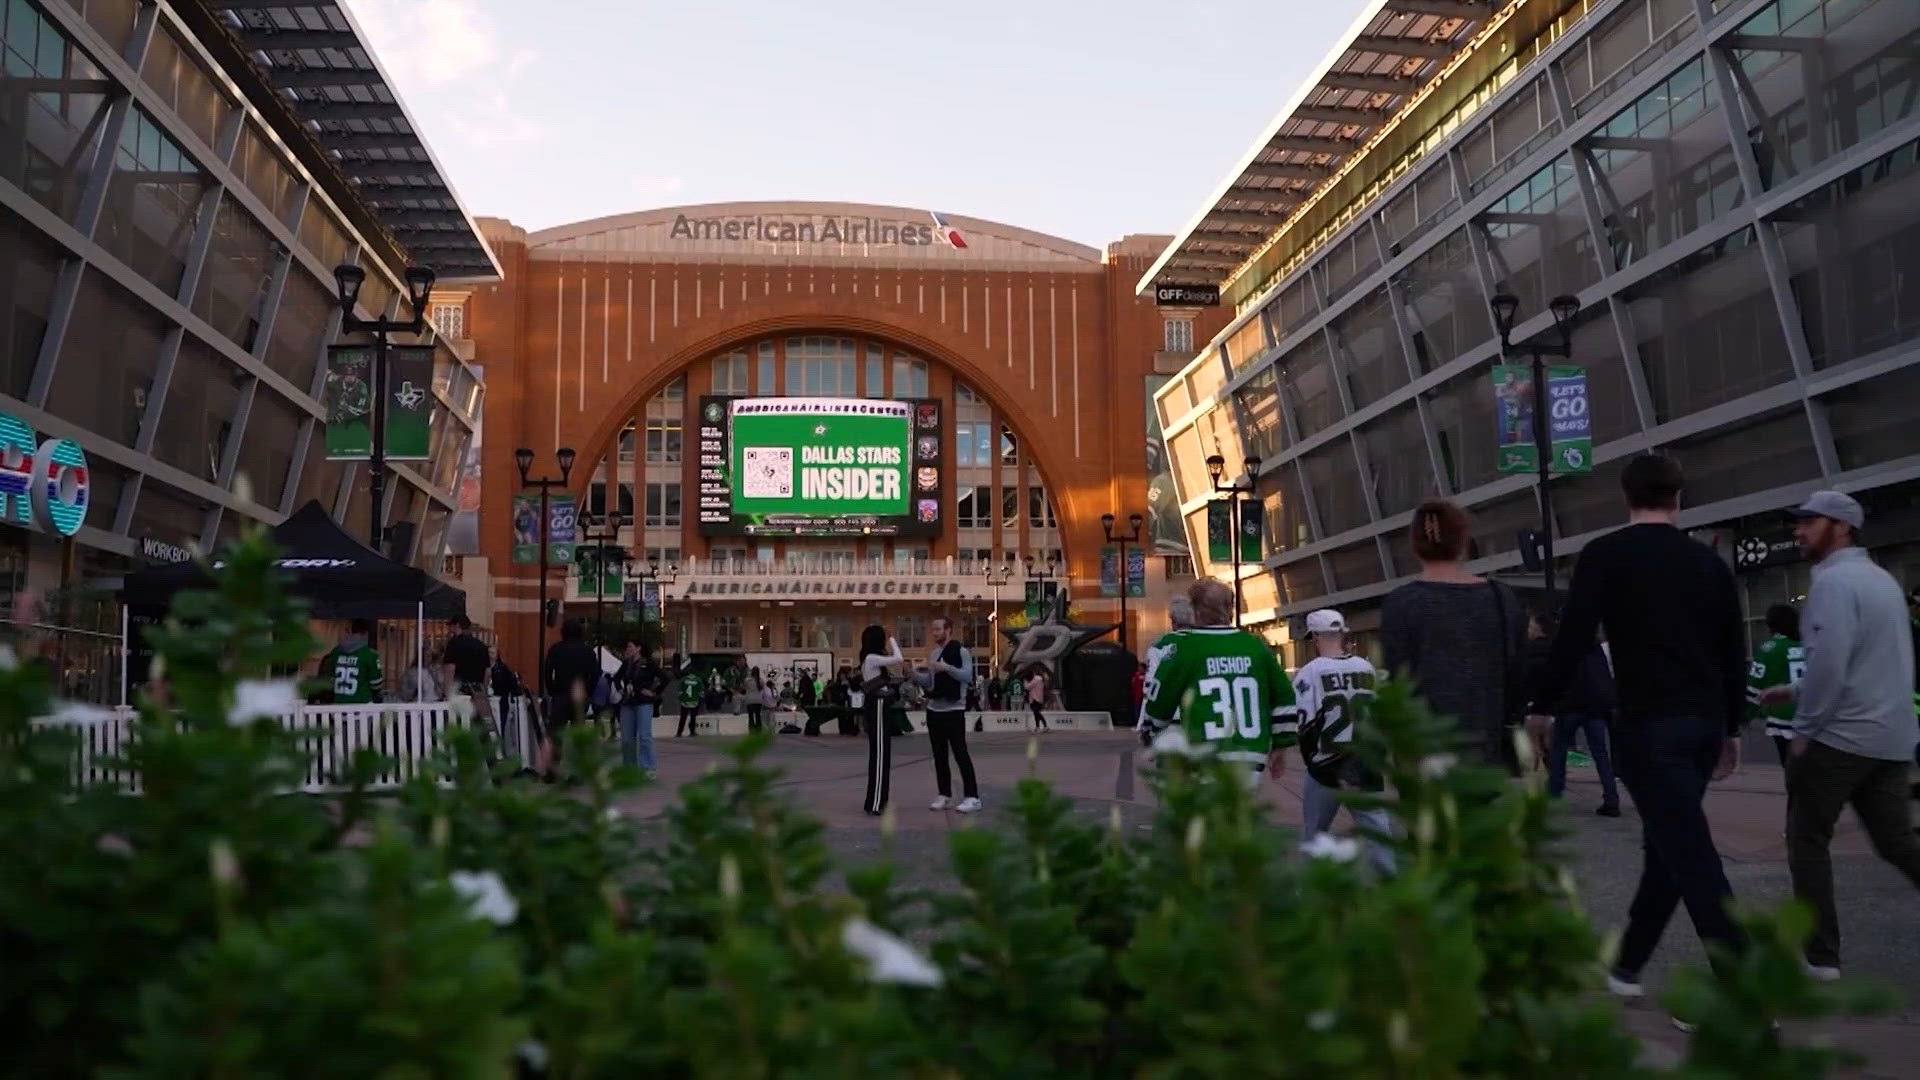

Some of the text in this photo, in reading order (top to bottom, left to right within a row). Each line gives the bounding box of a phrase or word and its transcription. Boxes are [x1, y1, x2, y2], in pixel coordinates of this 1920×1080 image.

[1552, 396, 1587, 419] GO
[801, 447, 901, 464] DALLAS STARS
[801, 467, 901, 500] INSIDER
[551, 515, 574, 529] GO
[1206, 656, 1251, 676] BISHOP
[334, 666, 359, 696] 25
[1199, 676, 1261, 740] 30
